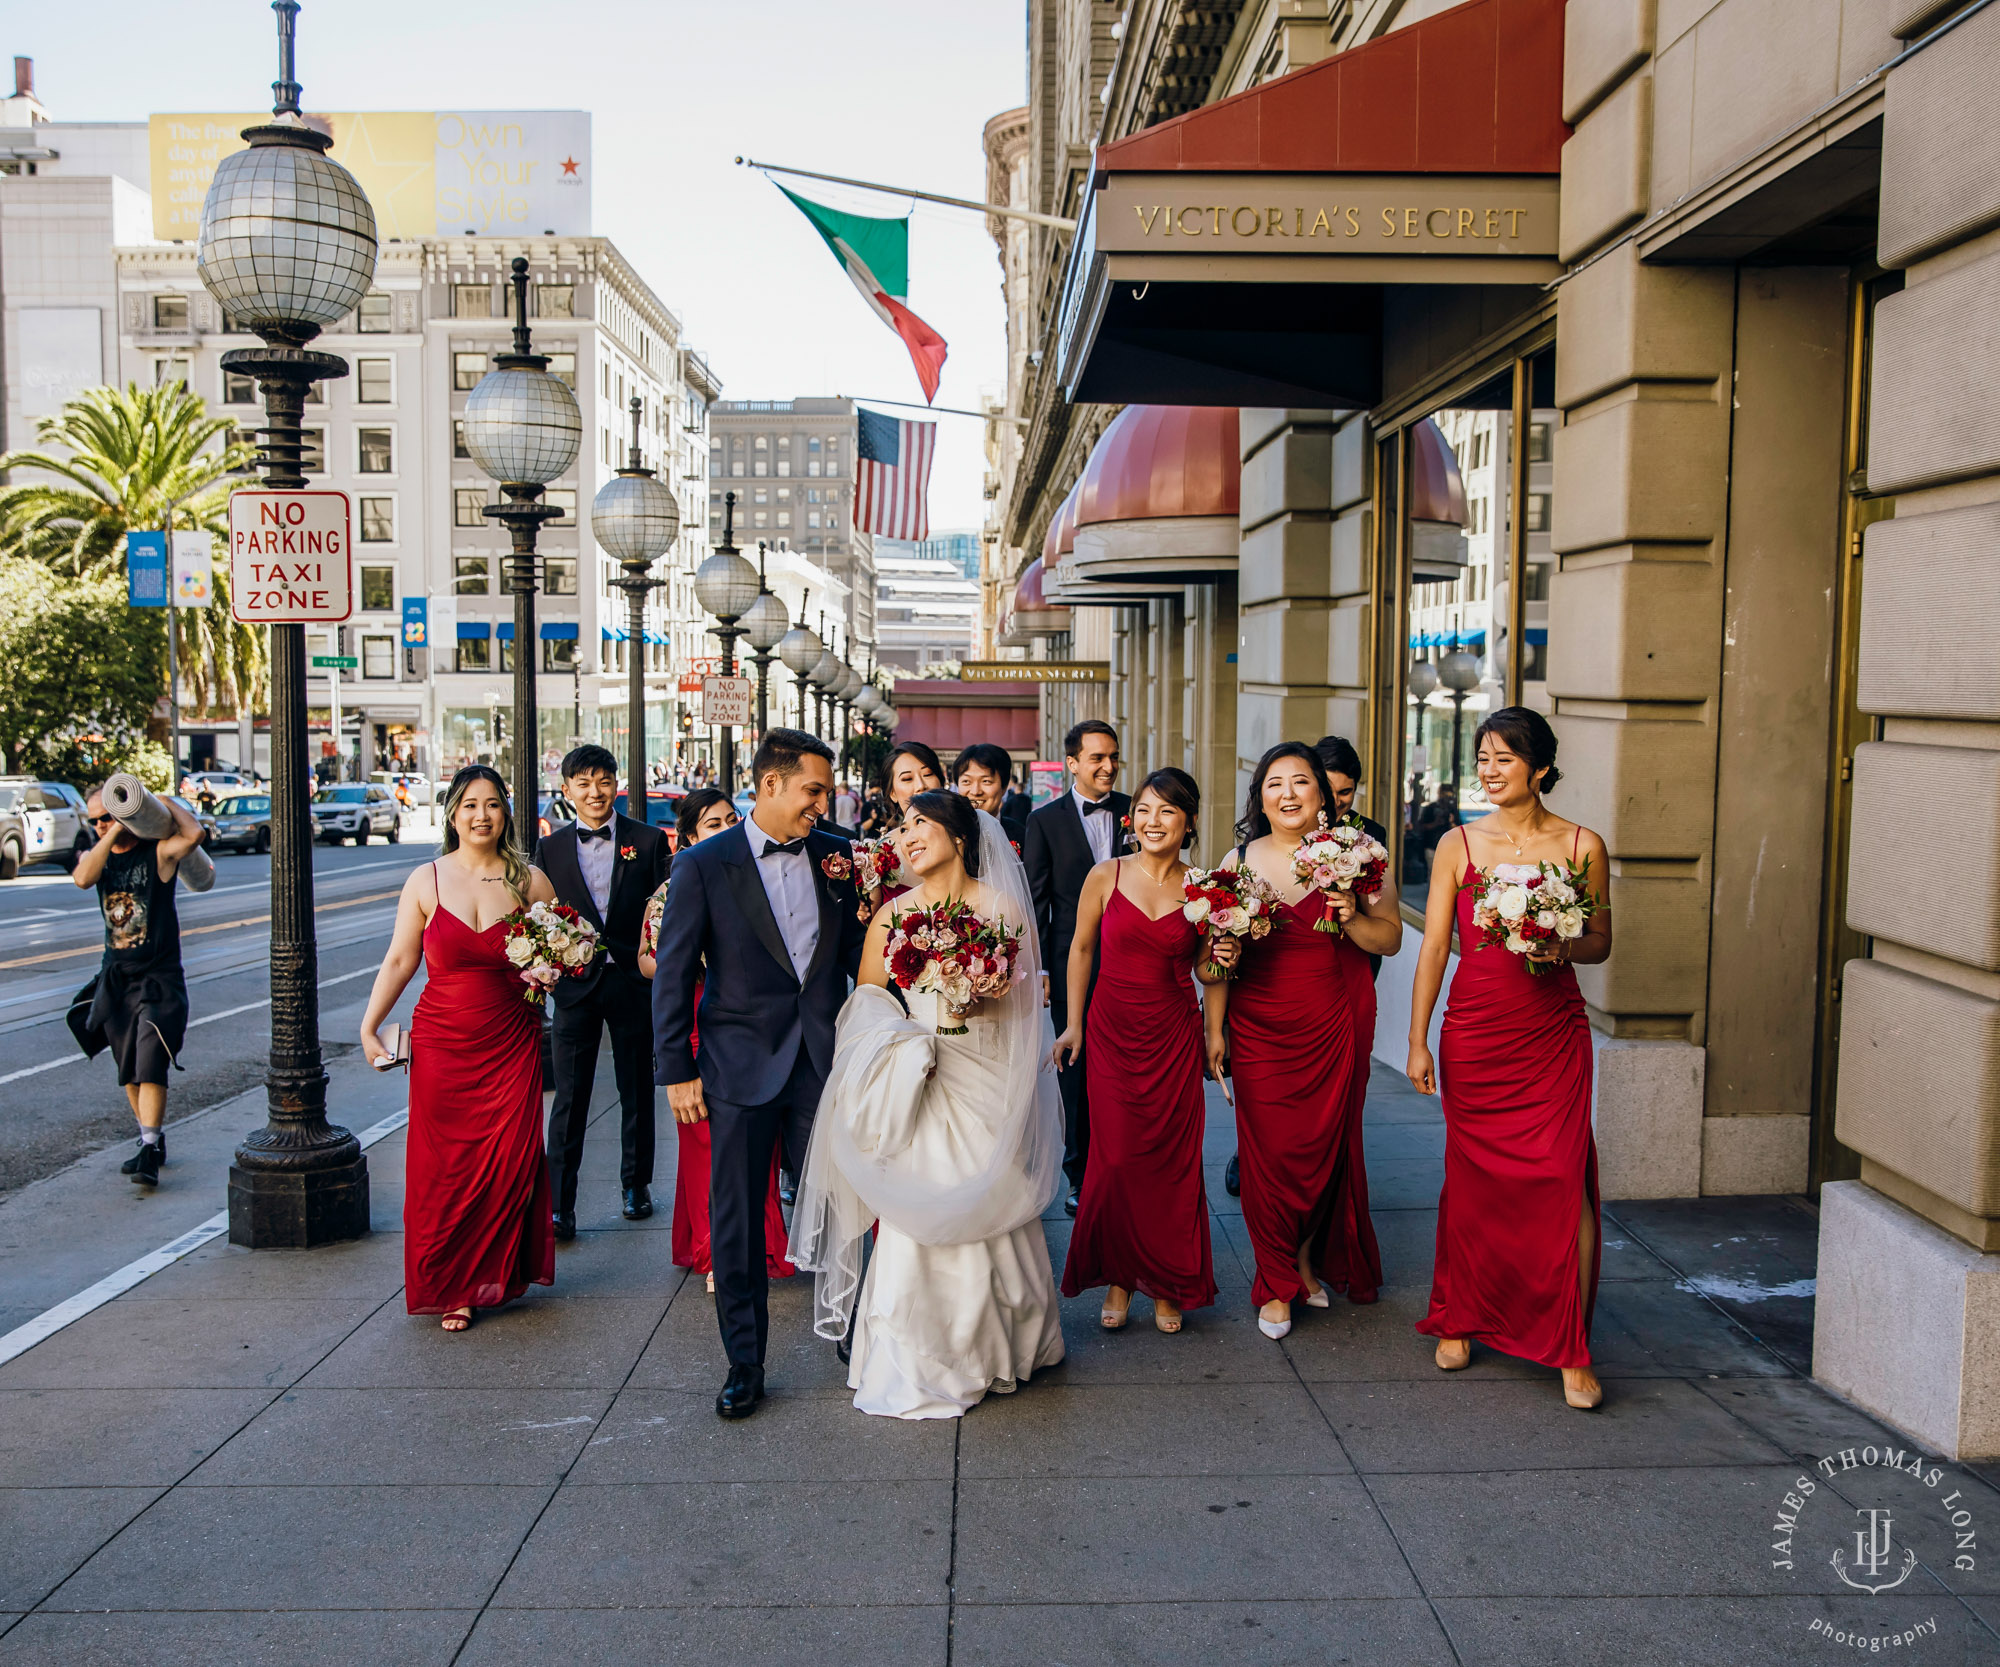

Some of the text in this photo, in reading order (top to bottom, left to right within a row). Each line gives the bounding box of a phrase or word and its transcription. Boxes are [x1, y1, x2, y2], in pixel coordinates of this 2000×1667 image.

[168, 122, 237, 139] The first
[434, 113, 523, 149] Own
[168, 144, 219, 164] day of
[459, 151, 540, 186] Your
[437, 186, 529, 232] Style
[1133, 205, 1527, 239] VICTORIA'S SECRET
[260, 502, 305, 525] NO
[236, 530, 340, 554] PARKING
[250, 563, 322, 582] TAXI
[247, 590, 330, 609] ZONE
[718, 681, 735, 690] NO
[707, 691, 747, 701] PARKING
[714, 703, 740, 711] TAXI
[711, 713, 741, 721] ZONE
